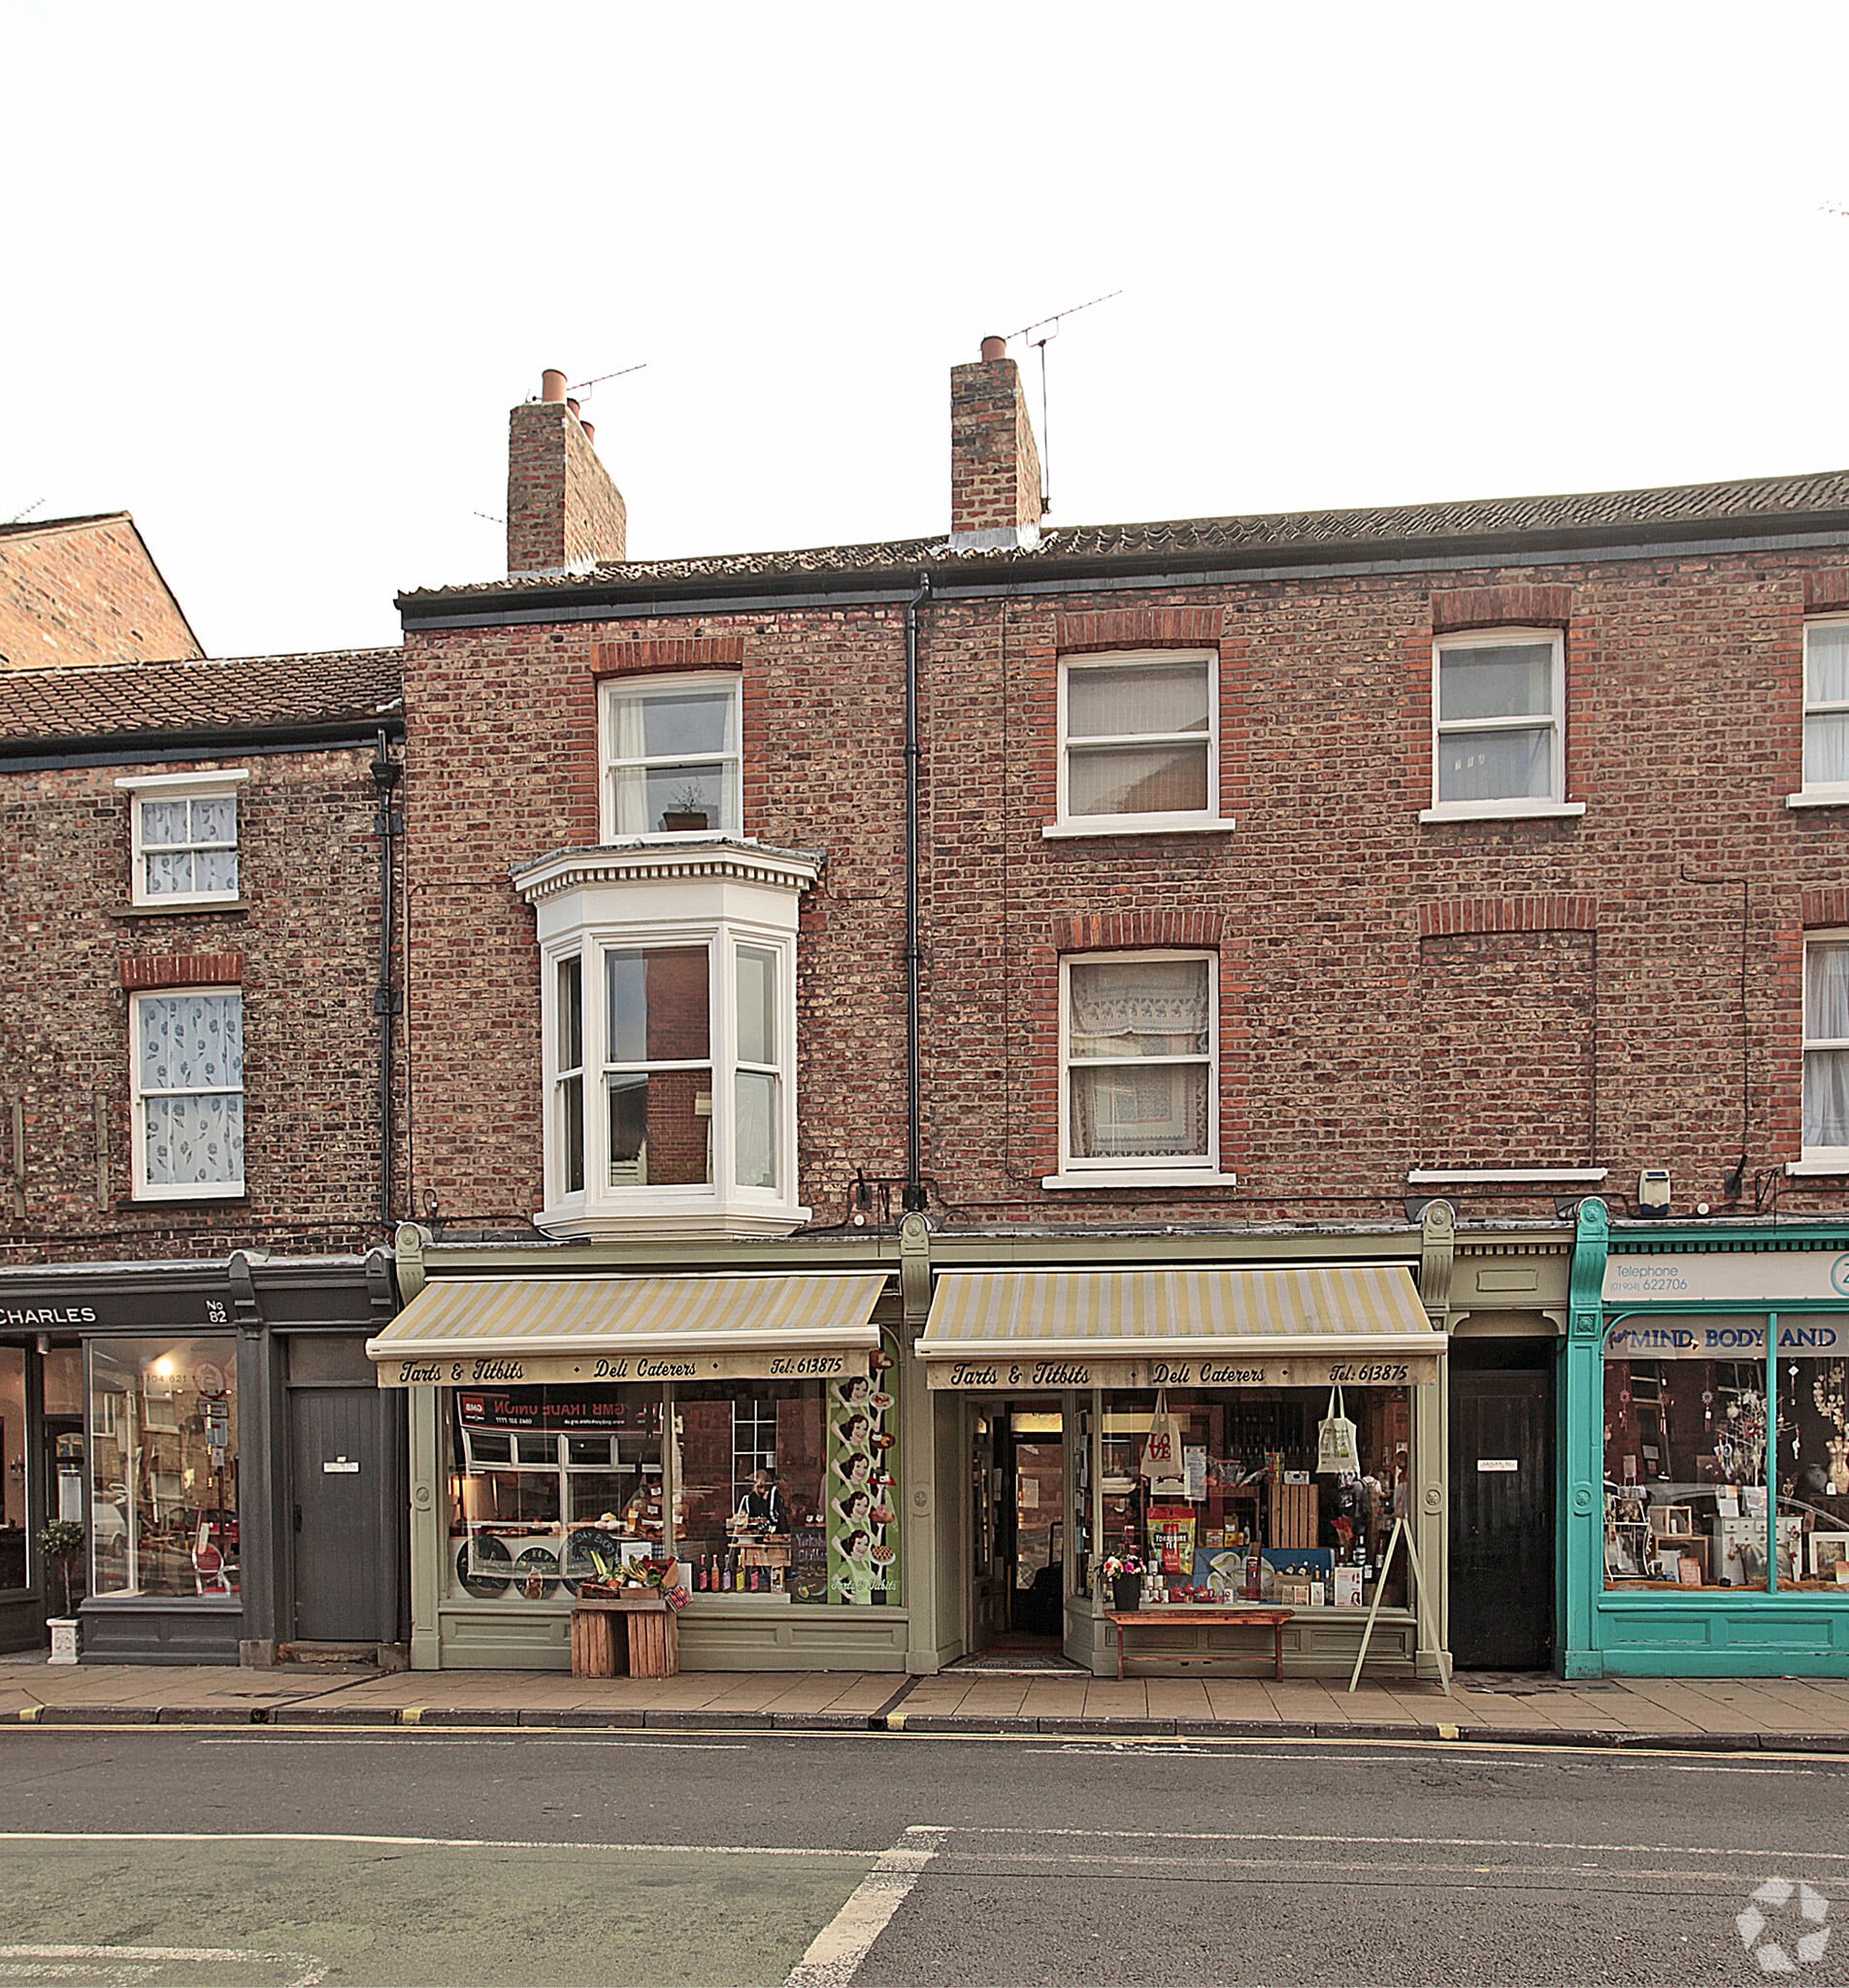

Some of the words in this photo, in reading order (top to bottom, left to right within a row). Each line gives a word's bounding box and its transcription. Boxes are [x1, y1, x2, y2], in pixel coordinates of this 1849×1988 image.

[1617, 1265, 1678, 1279] Telephone
[1610, 1281, 1640, 1292] (01904)
[1642, 1278, 1688, 1291] 622706
[206, 1301, 223, 1310] No
[0, 1307, 96, 1325] CHARLES
[210, 1310, 227, 1323] 82
[1705, 1328, 1765, 1348] BODY
[1779, 1328, 1837, 1347] AND
[399, 1361, 443, 1382] Tarts
[450, 1364, 464, 1381] &
[472, 1359, 525, 1380] Titbits
[593, 1358, 628, 1378] Deli
[636, 1357, 697, 1377] Caterers
[770, 1358, 795, 1375] Tel:
[797, 1357, 843, 1374] 613875
[950, 1362, 999, 1385] Tarts
[1008, 1365, 1022, 1384] &
[1032, 1362, 1091, 1384] Titbits
[1152, 1363, 1190, 1383] Deli
[1200, 1362, 1266, 1383] Caterers
[1329, 1365, 1356, 1381] Tel:
[1358, 1364, 1408, 1381] 613875
